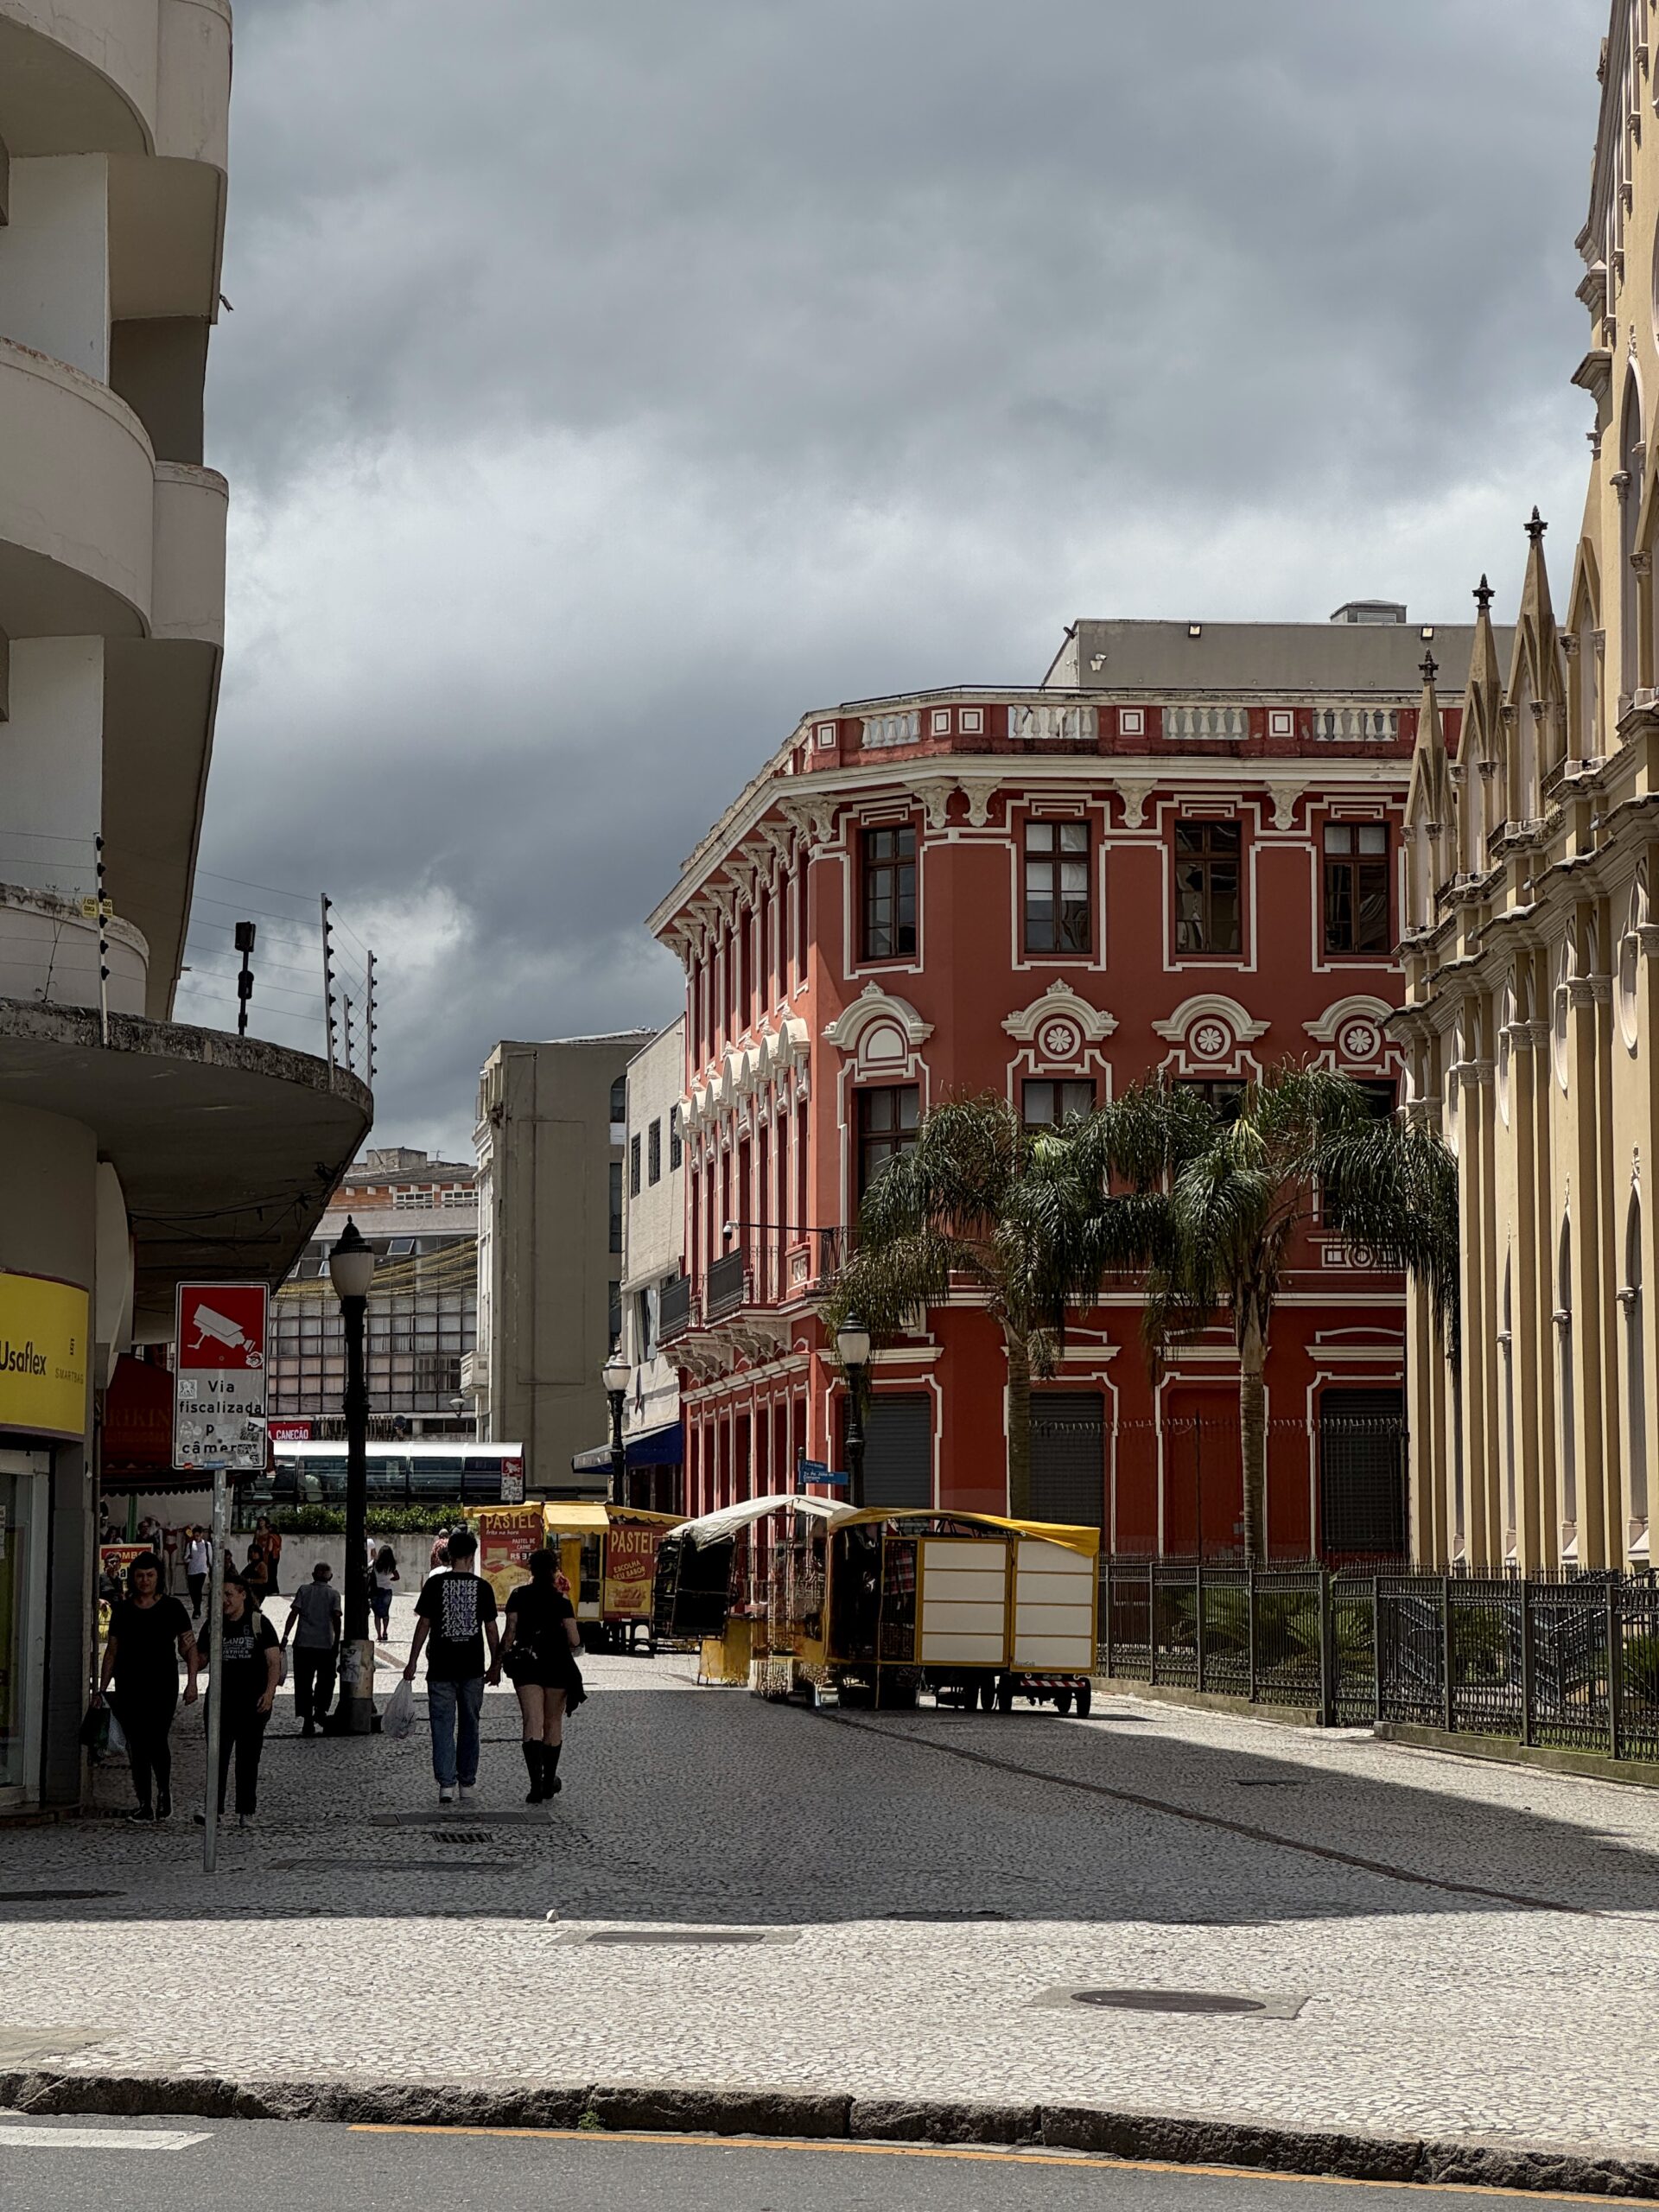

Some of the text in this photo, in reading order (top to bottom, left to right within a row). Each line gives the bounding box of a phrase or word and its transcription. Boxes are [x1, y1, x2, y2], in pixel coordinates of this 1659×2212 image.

[0, 1340, 47, 1376] Usaflex
[55, 1368, 84, 1384] SMARTBAG
[208, 1380, 235, 1393] Via
[180, 1401, 262, 1414] fiscalizada
[276, 1427, 309, 1440] CANECÃO
[181, 1440, 240, 1454] câmer
[486, 1515, 536, 1529] PASTEL
[613, 1560, 641, 1573] ESCOLHA
[626, 1566, 645, 1579] SABOR
